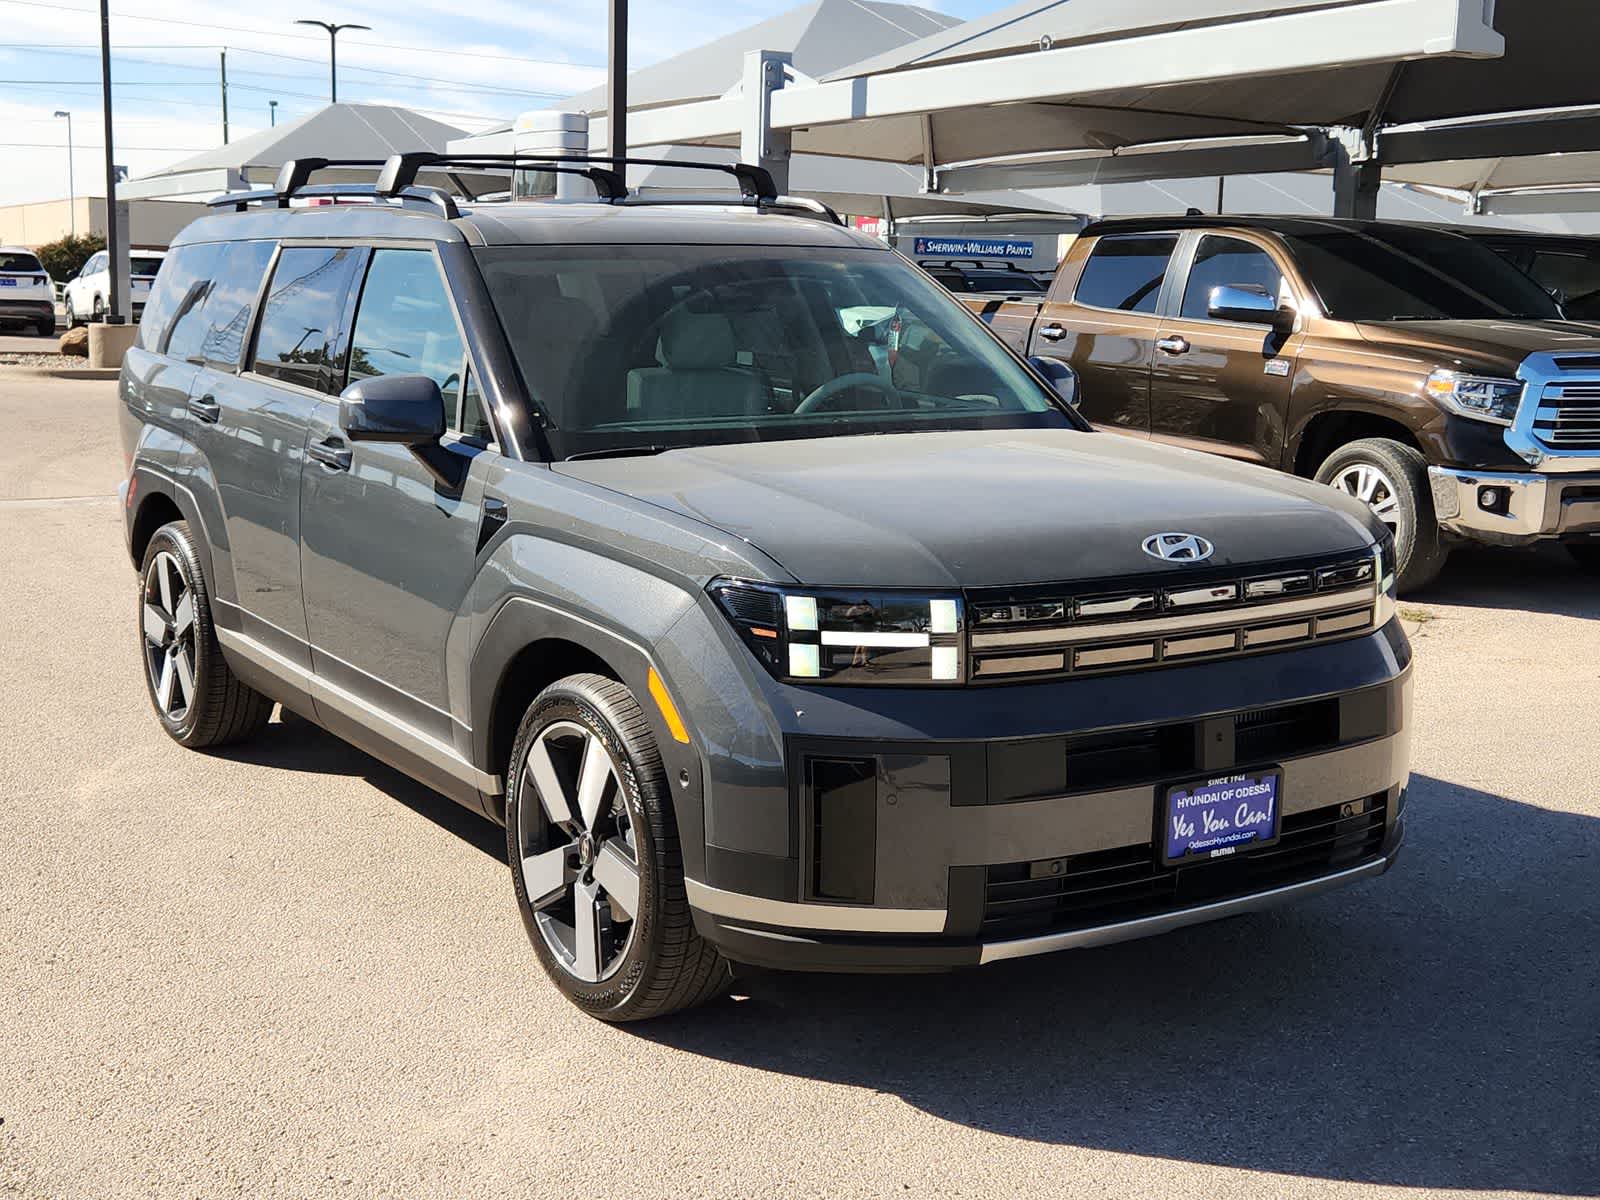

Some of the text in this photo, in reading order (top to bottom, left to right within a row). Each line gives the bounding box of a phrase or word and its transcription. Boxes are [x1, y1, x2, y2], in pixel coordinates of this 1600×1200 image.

[926, 241, 1032, 256] SHERWIN-WILLIAMS PAINTS
[1207, 777, 1228, 787] SINCE
[1177, 784, 1271, 809] HYUNDAI OF ODESSA
[1173, 797, 1274, 840] Yes You Can!
[1188, 831, 1257, 849] OdessaHyundai.com
